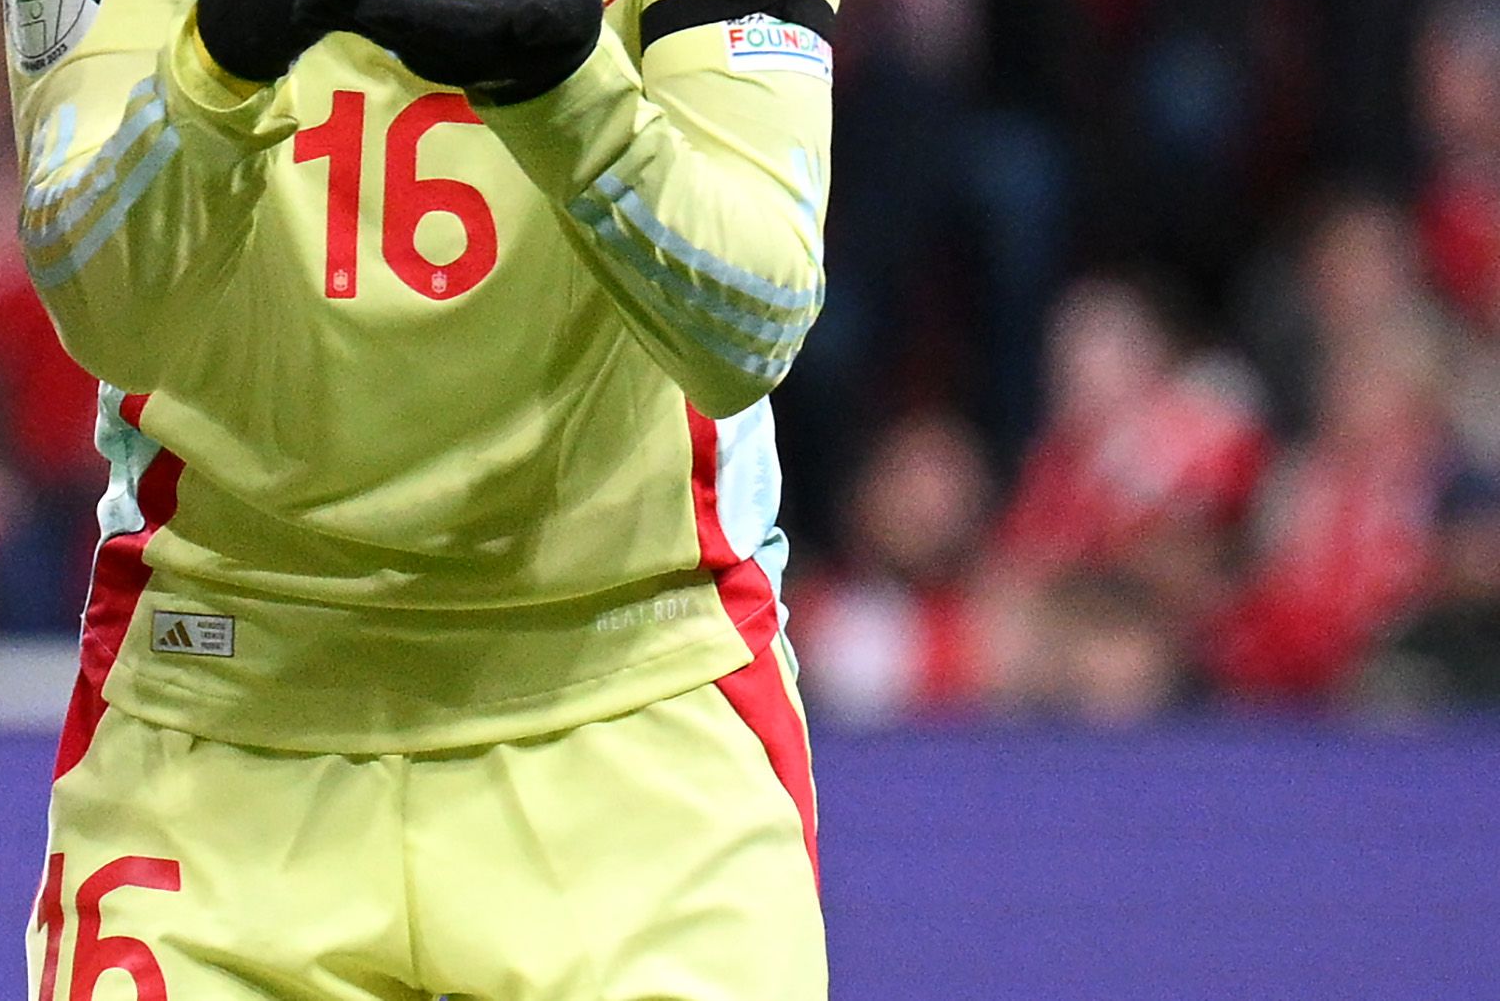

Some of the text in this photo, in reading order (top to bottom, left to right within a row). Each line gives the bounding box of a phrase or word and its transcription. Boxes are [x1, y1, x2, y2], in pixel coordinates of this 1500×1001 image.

[728, 28, 831, 56] FOUNDA
[294, 89, 499, 301] 16
[37, 852, 183, 1001] 16
